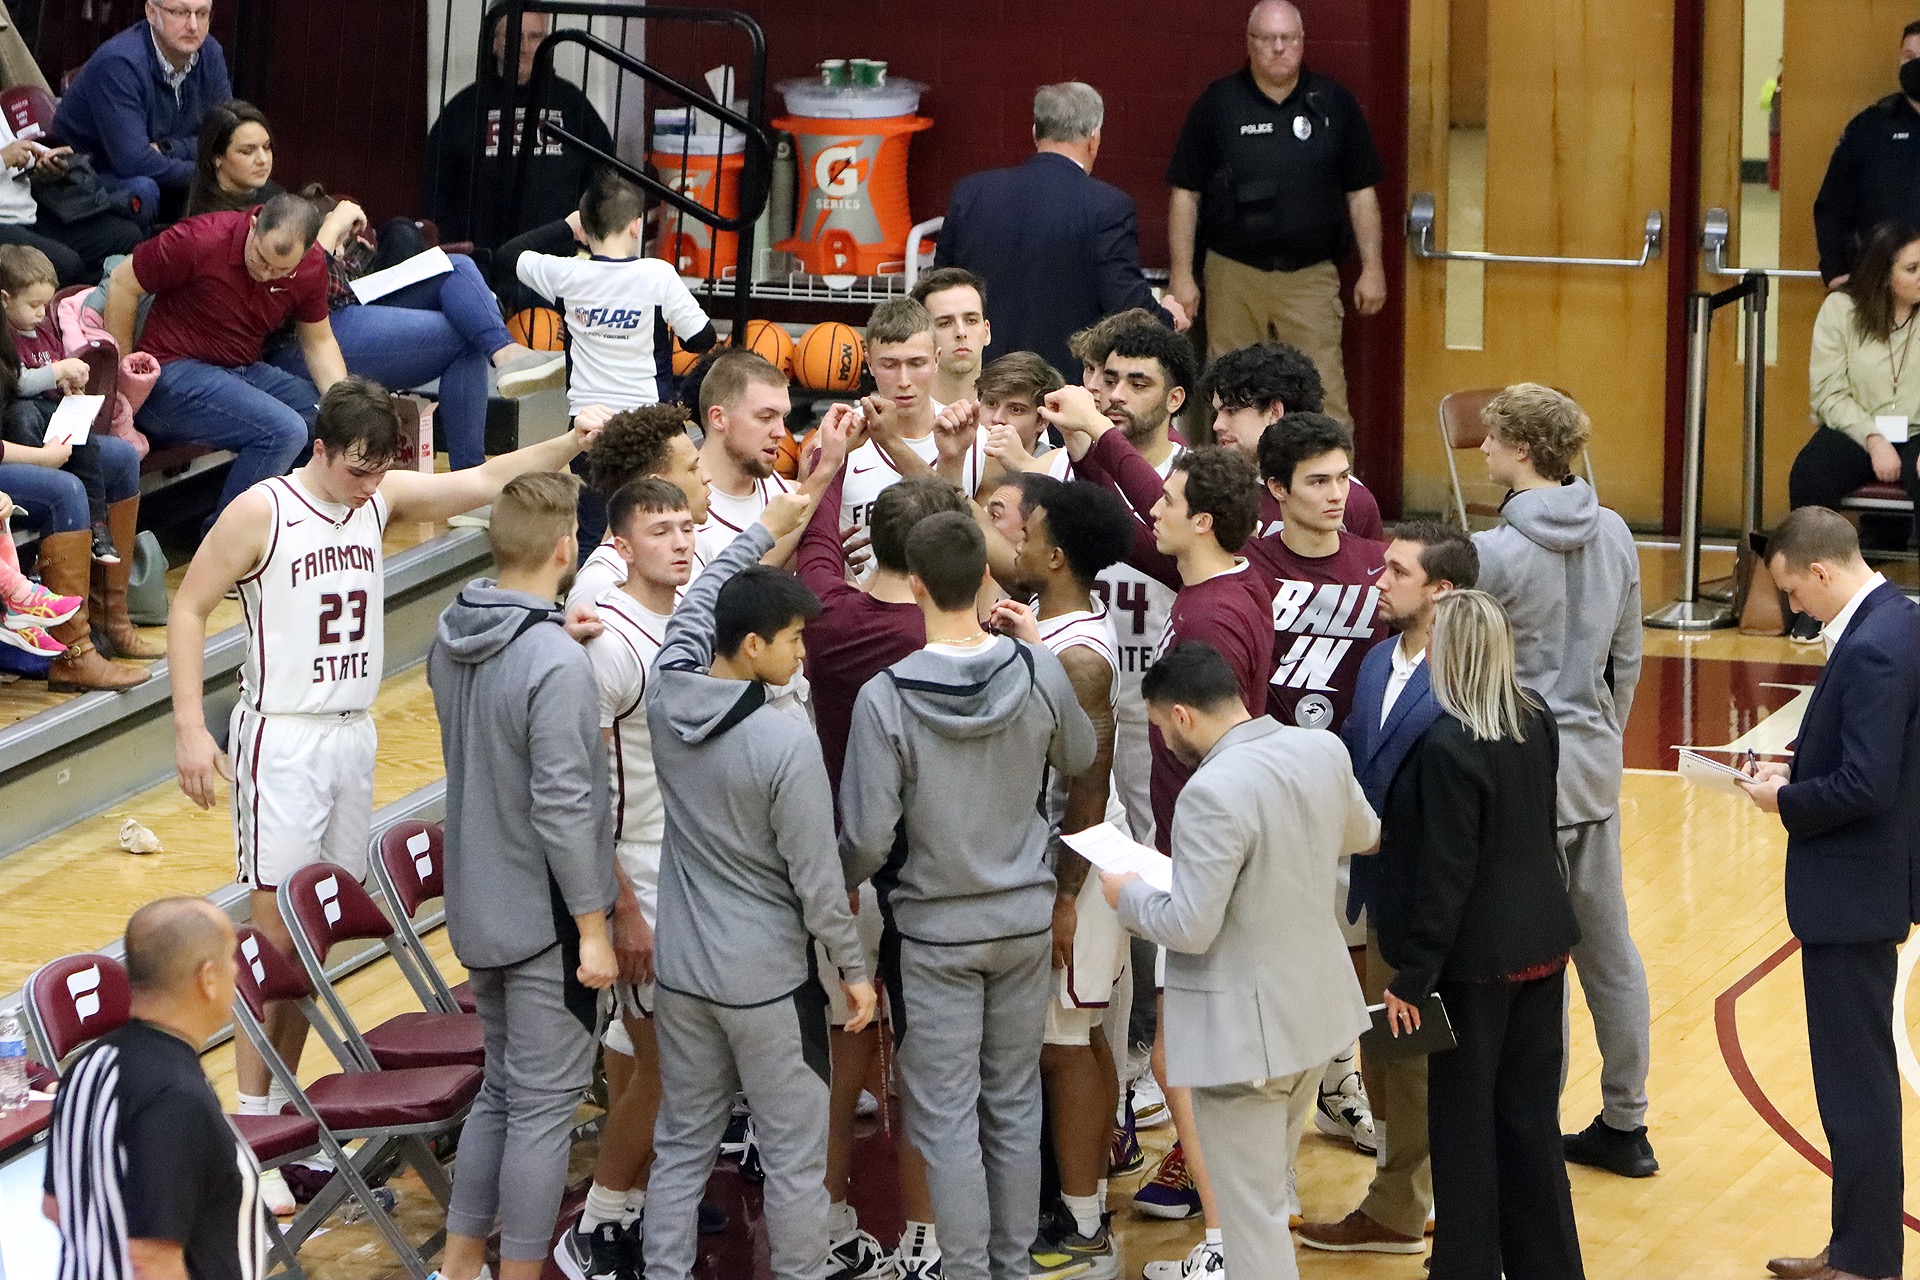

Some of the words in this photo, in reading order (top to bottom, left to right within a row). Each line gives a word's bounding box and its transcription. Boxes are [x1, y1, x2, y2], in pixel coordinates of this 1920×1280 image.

[1240, 123, 1274, 135] POLICE
[815, 146, 858, 197] G
[815, 199, 861, 210] SERIES
[586, 308, 642, 329] FLAG
[838, 343, 853, 381] NCAA
[290, 544, 376, 588] FAIRMON
[319, 589, 368, 646] 23
[1272, 578, 1380, 639] BALL
[312, 652, 369, 683] STATE
[1269, 635, 1353, 692] IN
